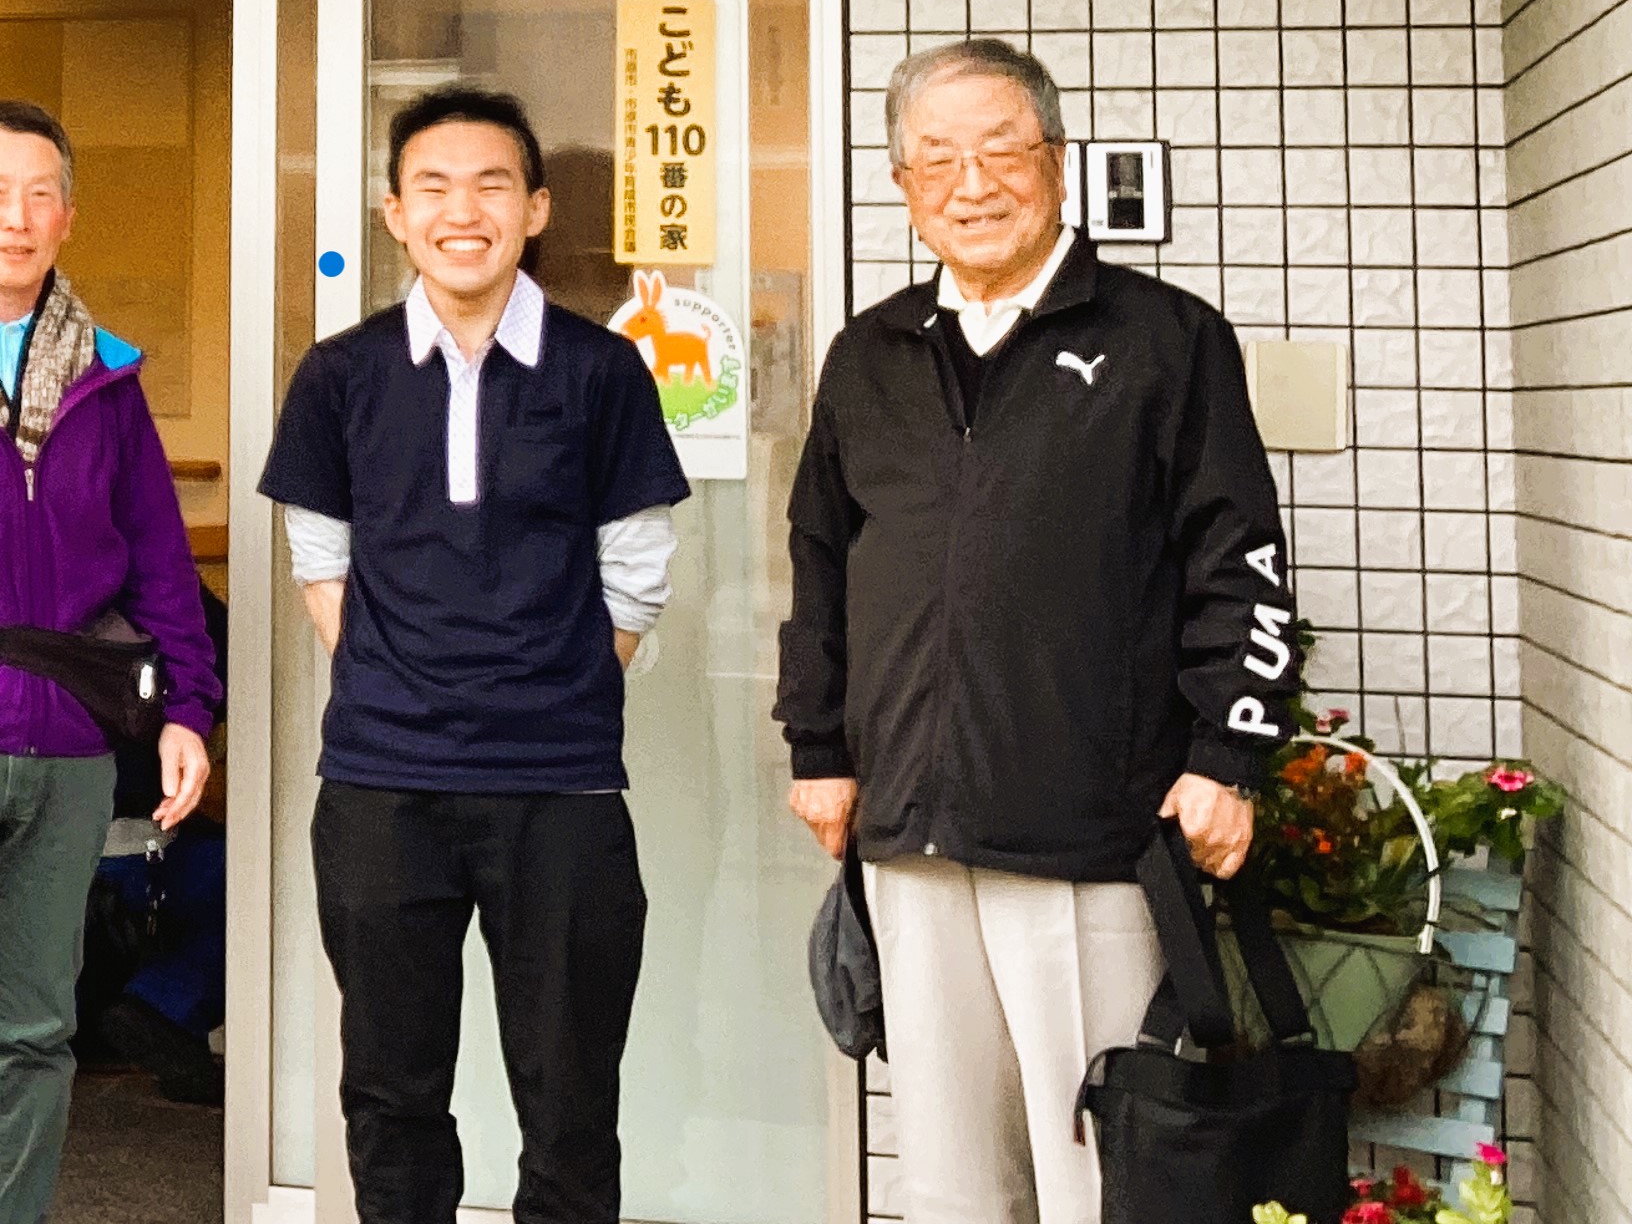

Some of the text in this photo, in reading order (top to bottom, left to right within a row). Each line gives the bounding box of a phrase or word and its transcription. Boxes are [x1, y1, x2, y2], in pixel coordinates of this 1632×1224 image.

[645, 6, 706, 251] こども110番の家
[674, 297, 736, 351] supporter
